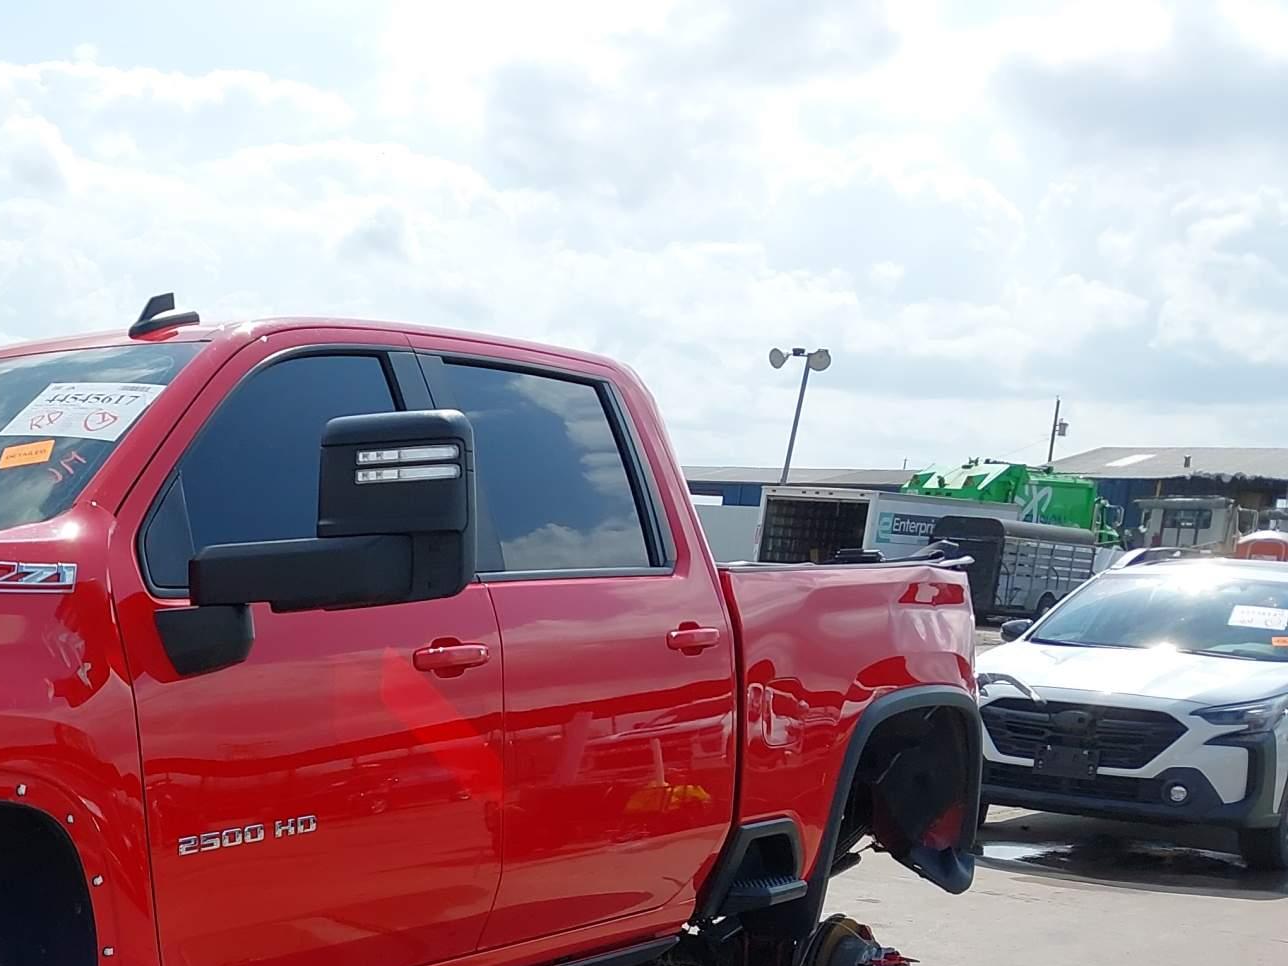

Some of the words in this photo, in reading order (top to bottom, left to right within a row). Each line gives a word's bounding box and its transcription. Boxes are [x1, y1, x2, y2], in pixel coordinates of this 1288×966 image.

[45, 393, 141, 406] 44545617
[178, 823, 265, 857] 2500
[275, 815, 318, 839] HD
